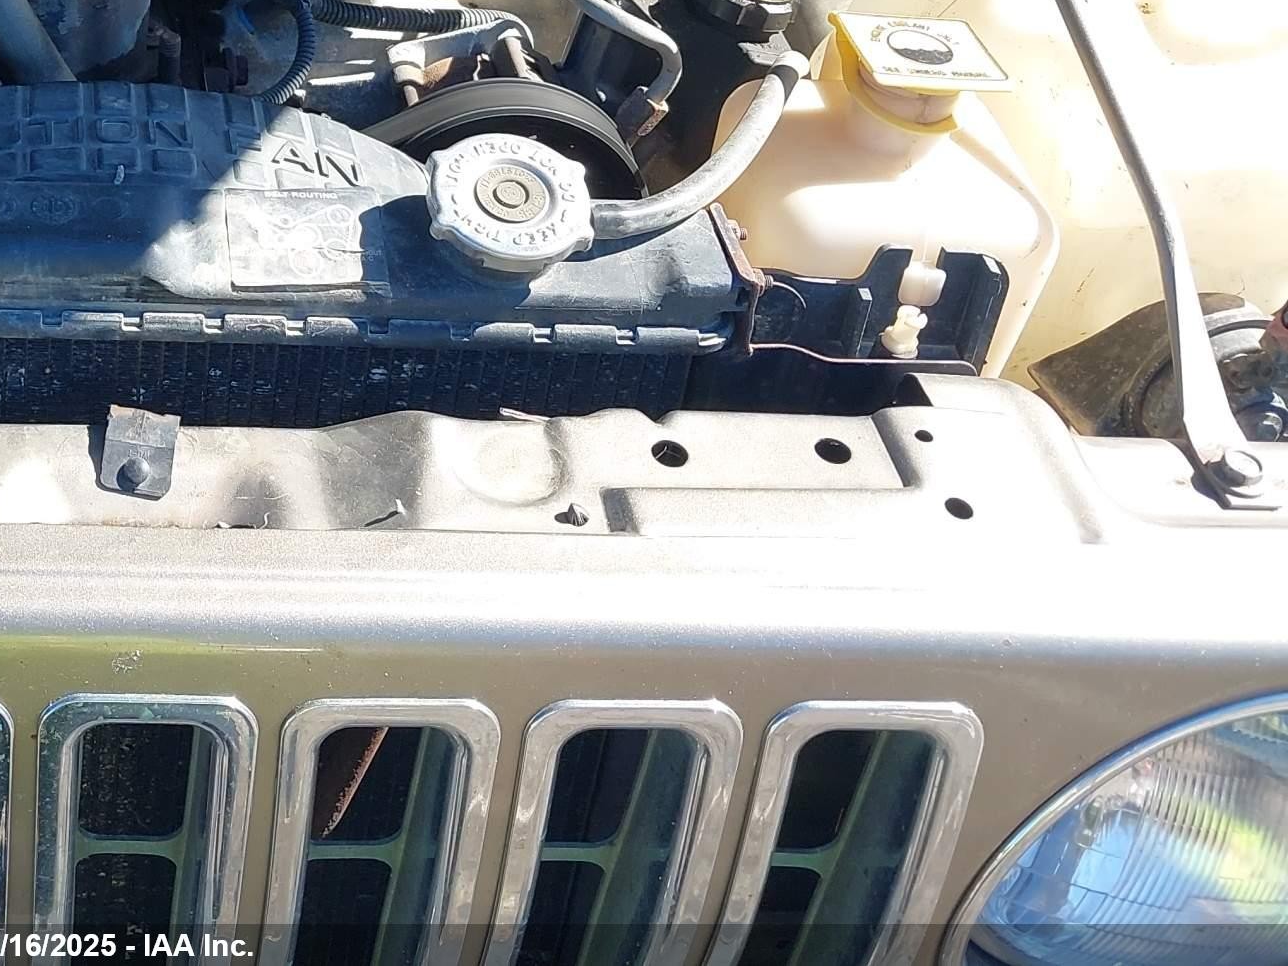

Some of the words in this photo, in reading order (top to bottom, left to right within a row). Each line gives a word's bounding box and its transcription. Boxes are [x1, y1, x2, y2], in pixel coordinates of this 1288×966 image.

[226, 128, 360, 187] FAN
[264, 191, 290, 199] BELT
[291, 191, 338, 200] ROUTING
